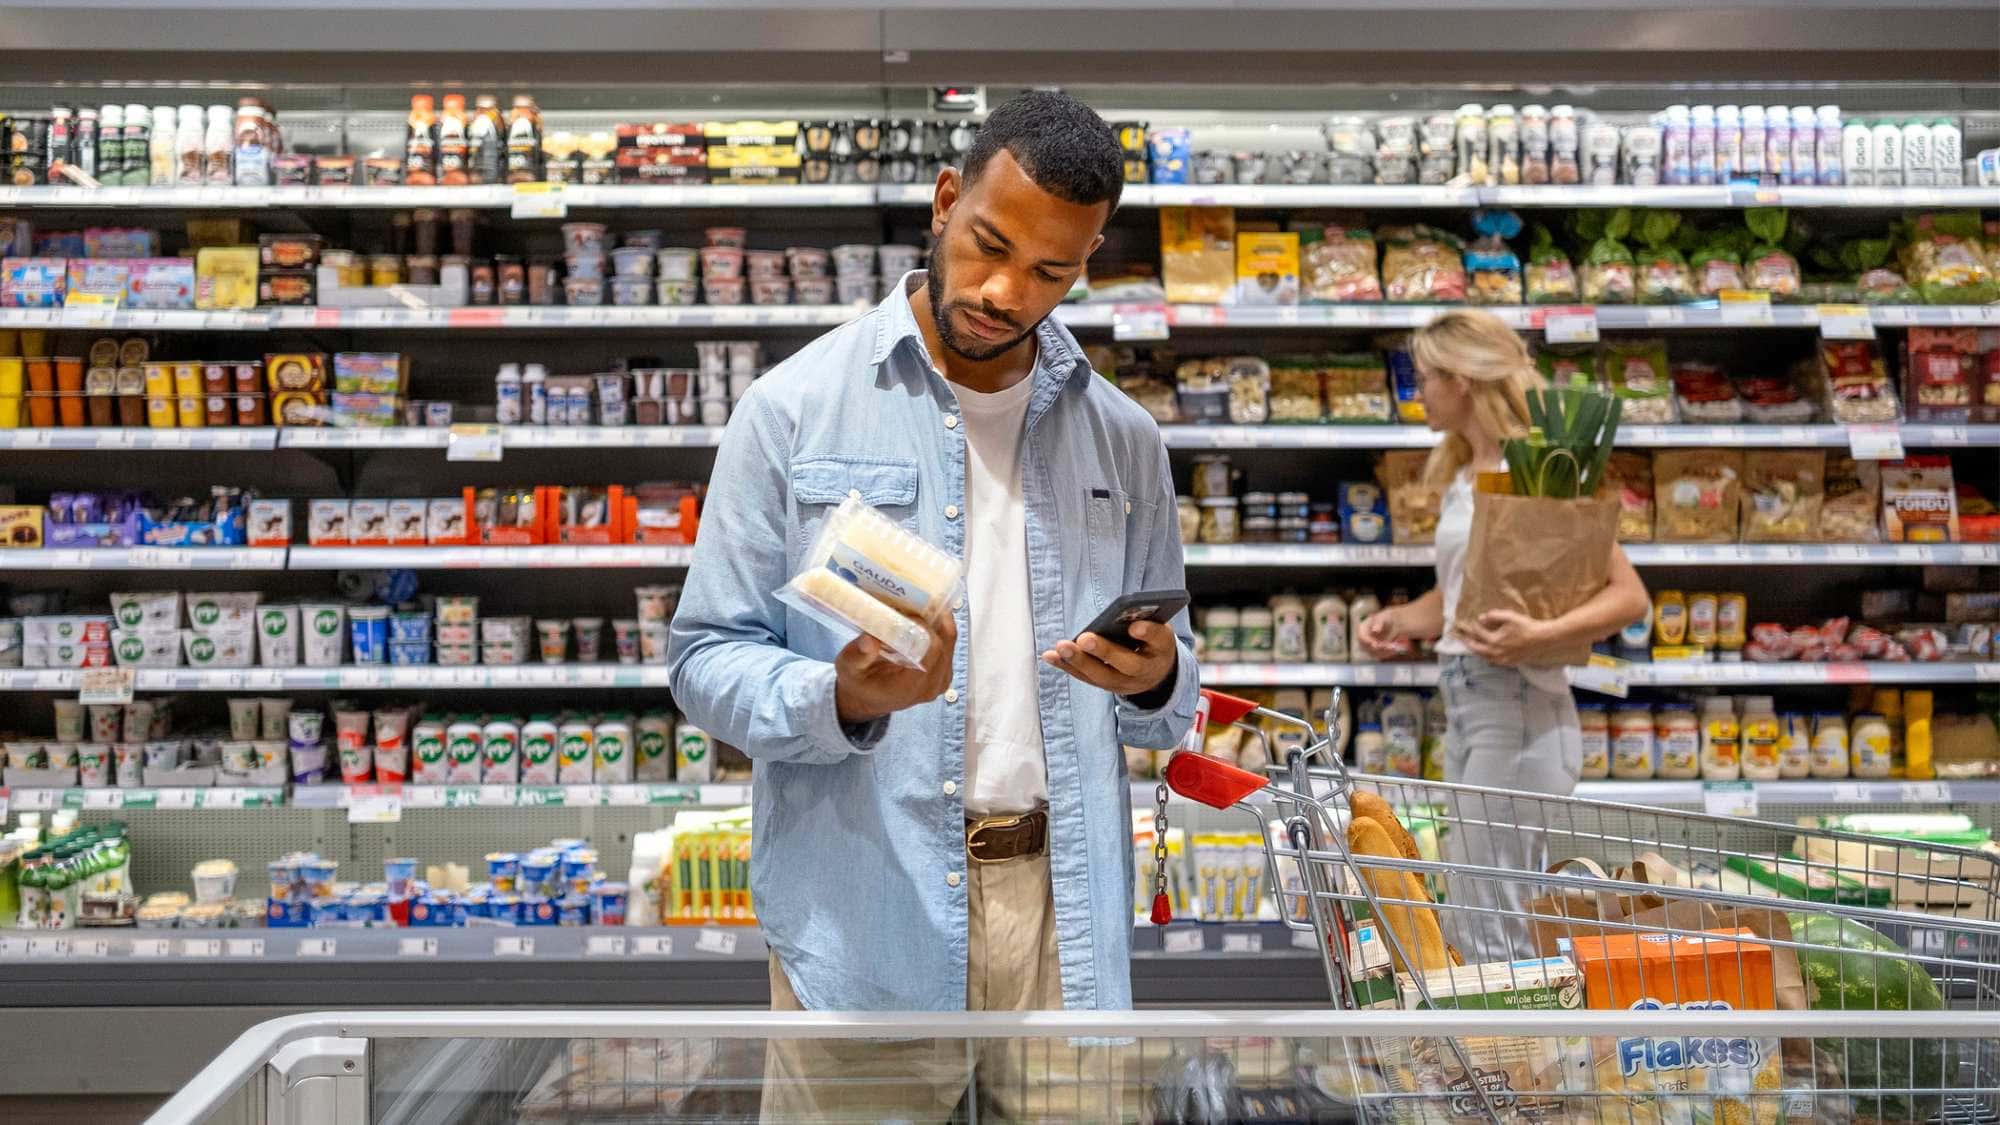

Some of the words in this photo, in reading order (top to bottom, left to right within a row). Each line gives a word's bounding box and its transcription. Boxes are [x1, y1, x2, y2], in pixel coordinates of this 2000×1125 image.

[853, 560, 906, 596] GAUDA
[1533, 993, 1557, 1002] Gran
[1621, 1037, 1752, 1074] Flakes
